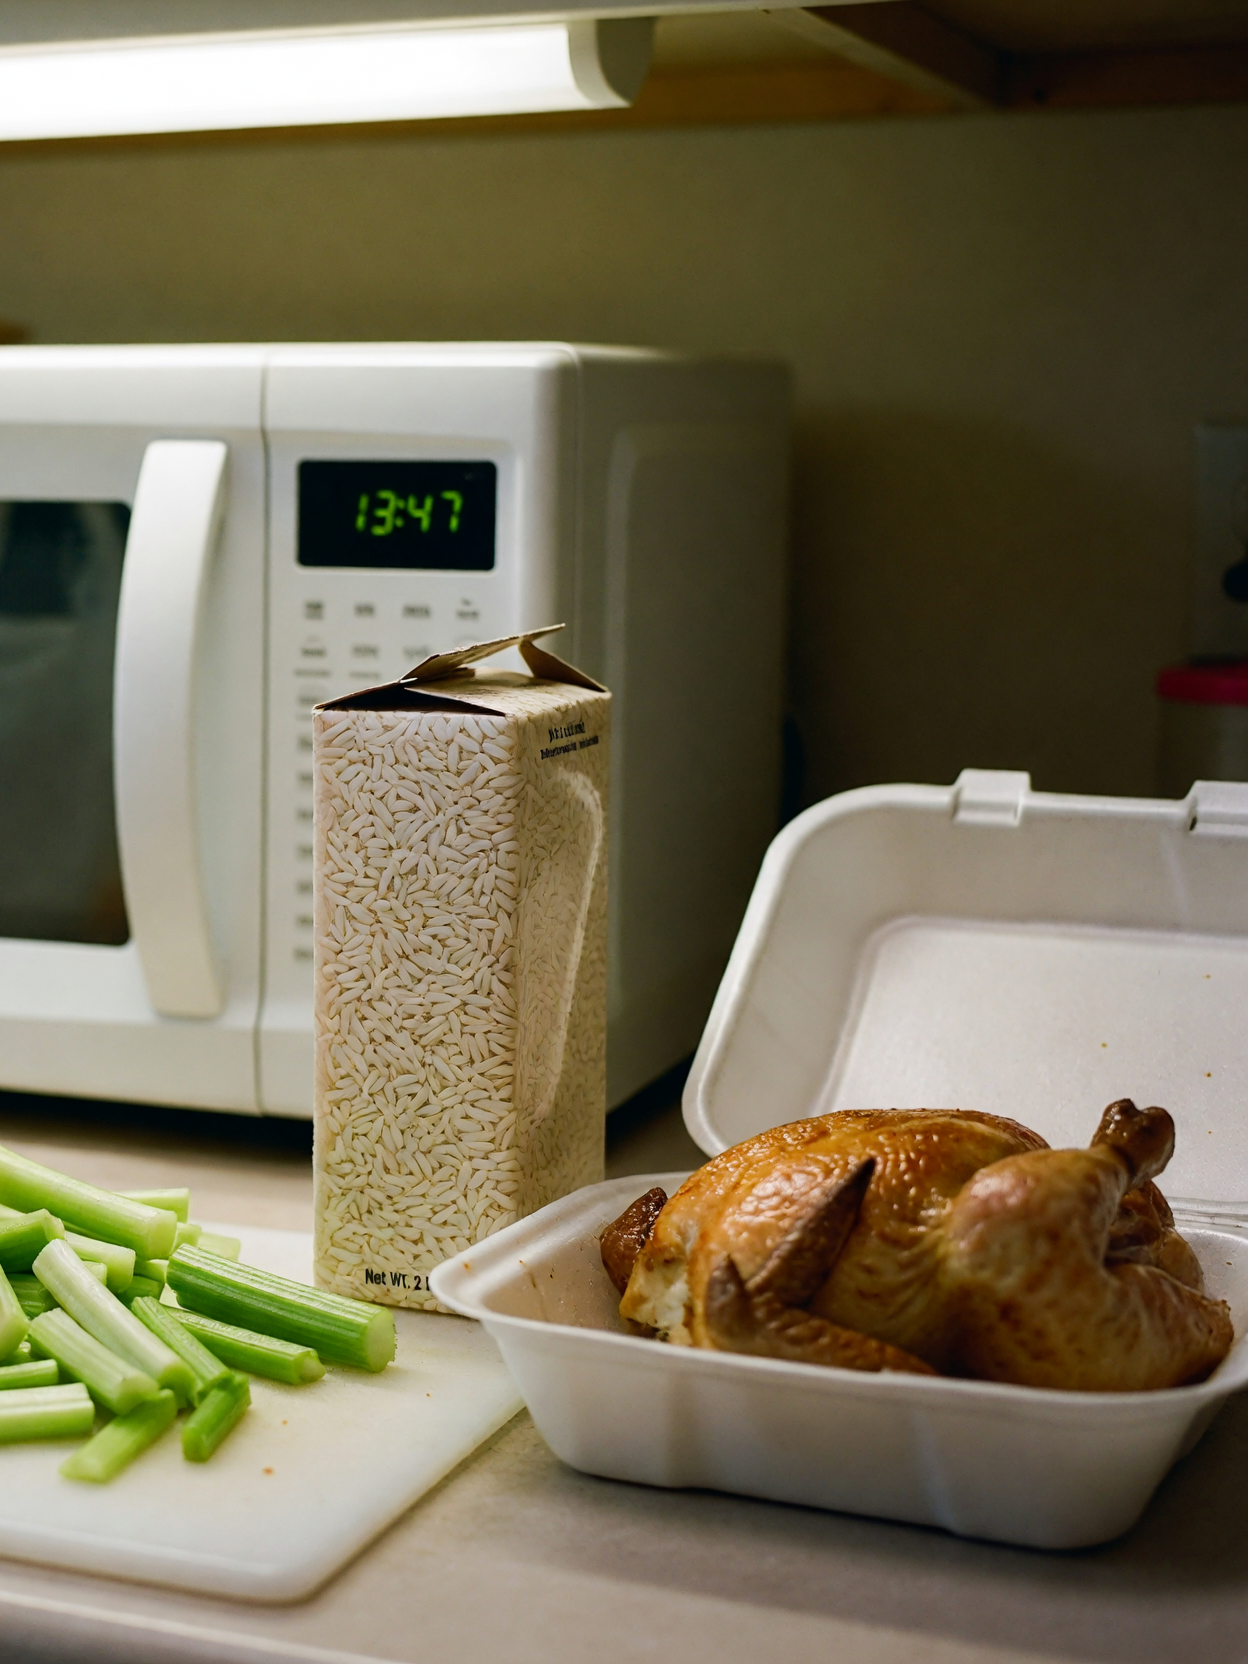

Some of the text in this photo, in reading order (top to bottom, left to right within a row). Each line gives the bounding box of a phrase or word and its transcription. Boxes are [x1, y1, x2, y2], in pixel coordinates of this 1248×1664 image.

[355, 489, 463, 536] 13:47
[365, 1267, 387, 1286] Net
[413, 1275, 422, 1291] 2
